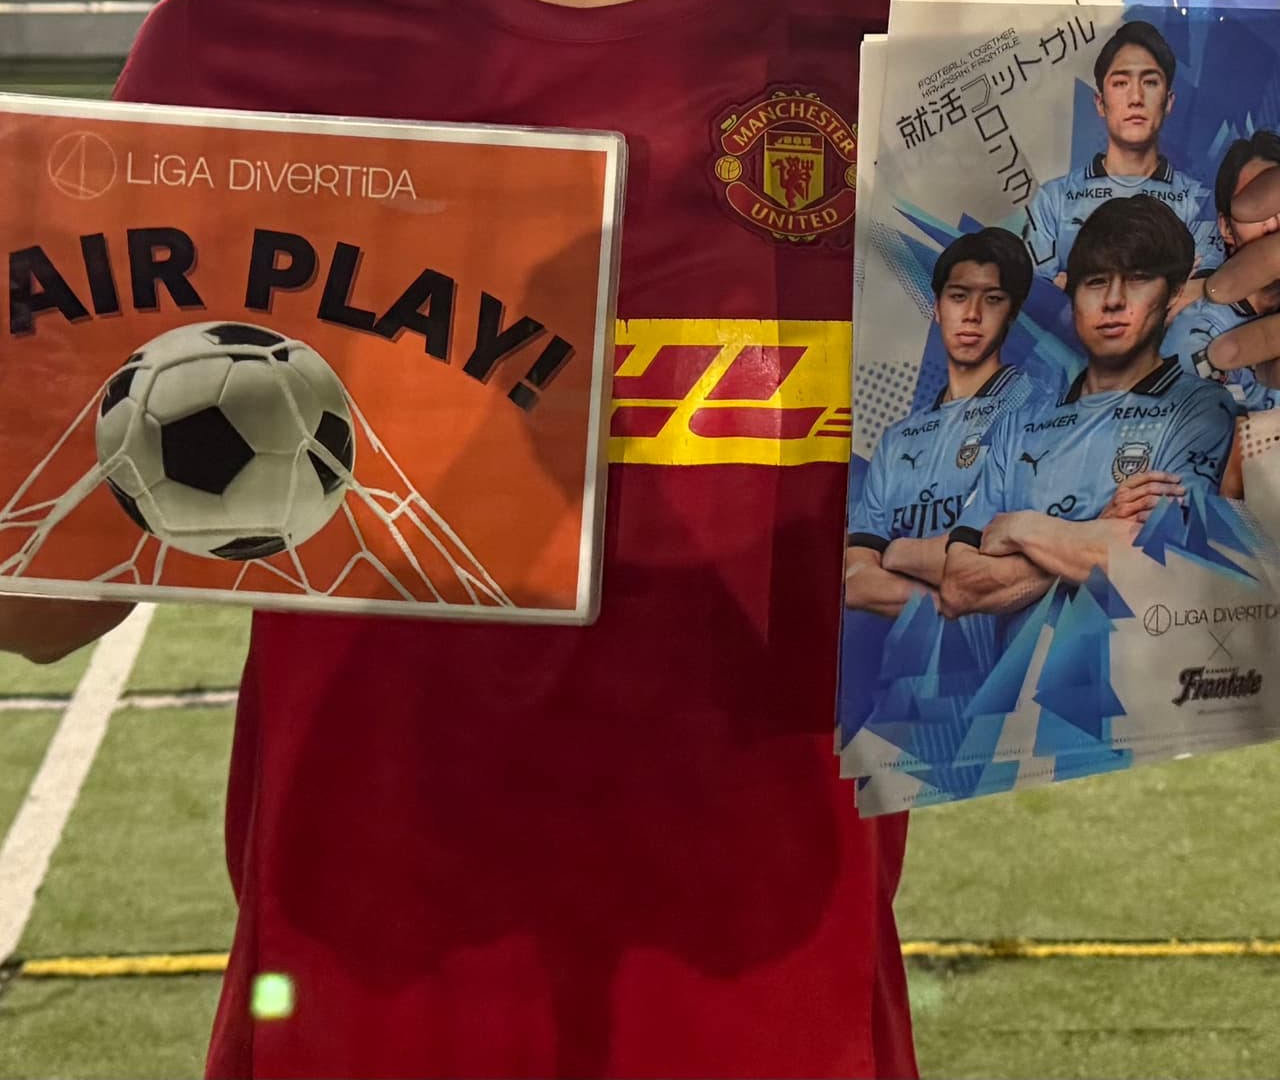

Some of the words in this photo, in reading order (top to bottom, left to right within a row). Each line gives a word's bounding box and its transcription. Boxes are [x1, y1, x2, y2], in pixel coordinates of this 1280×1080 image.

[733, 102, 855, 155] MANCHESTER
[1066, 187, 1113, 200] ANKER
[751, 202, 838, 230] UNITED
[245, 229, 574, 412] PLAY!
